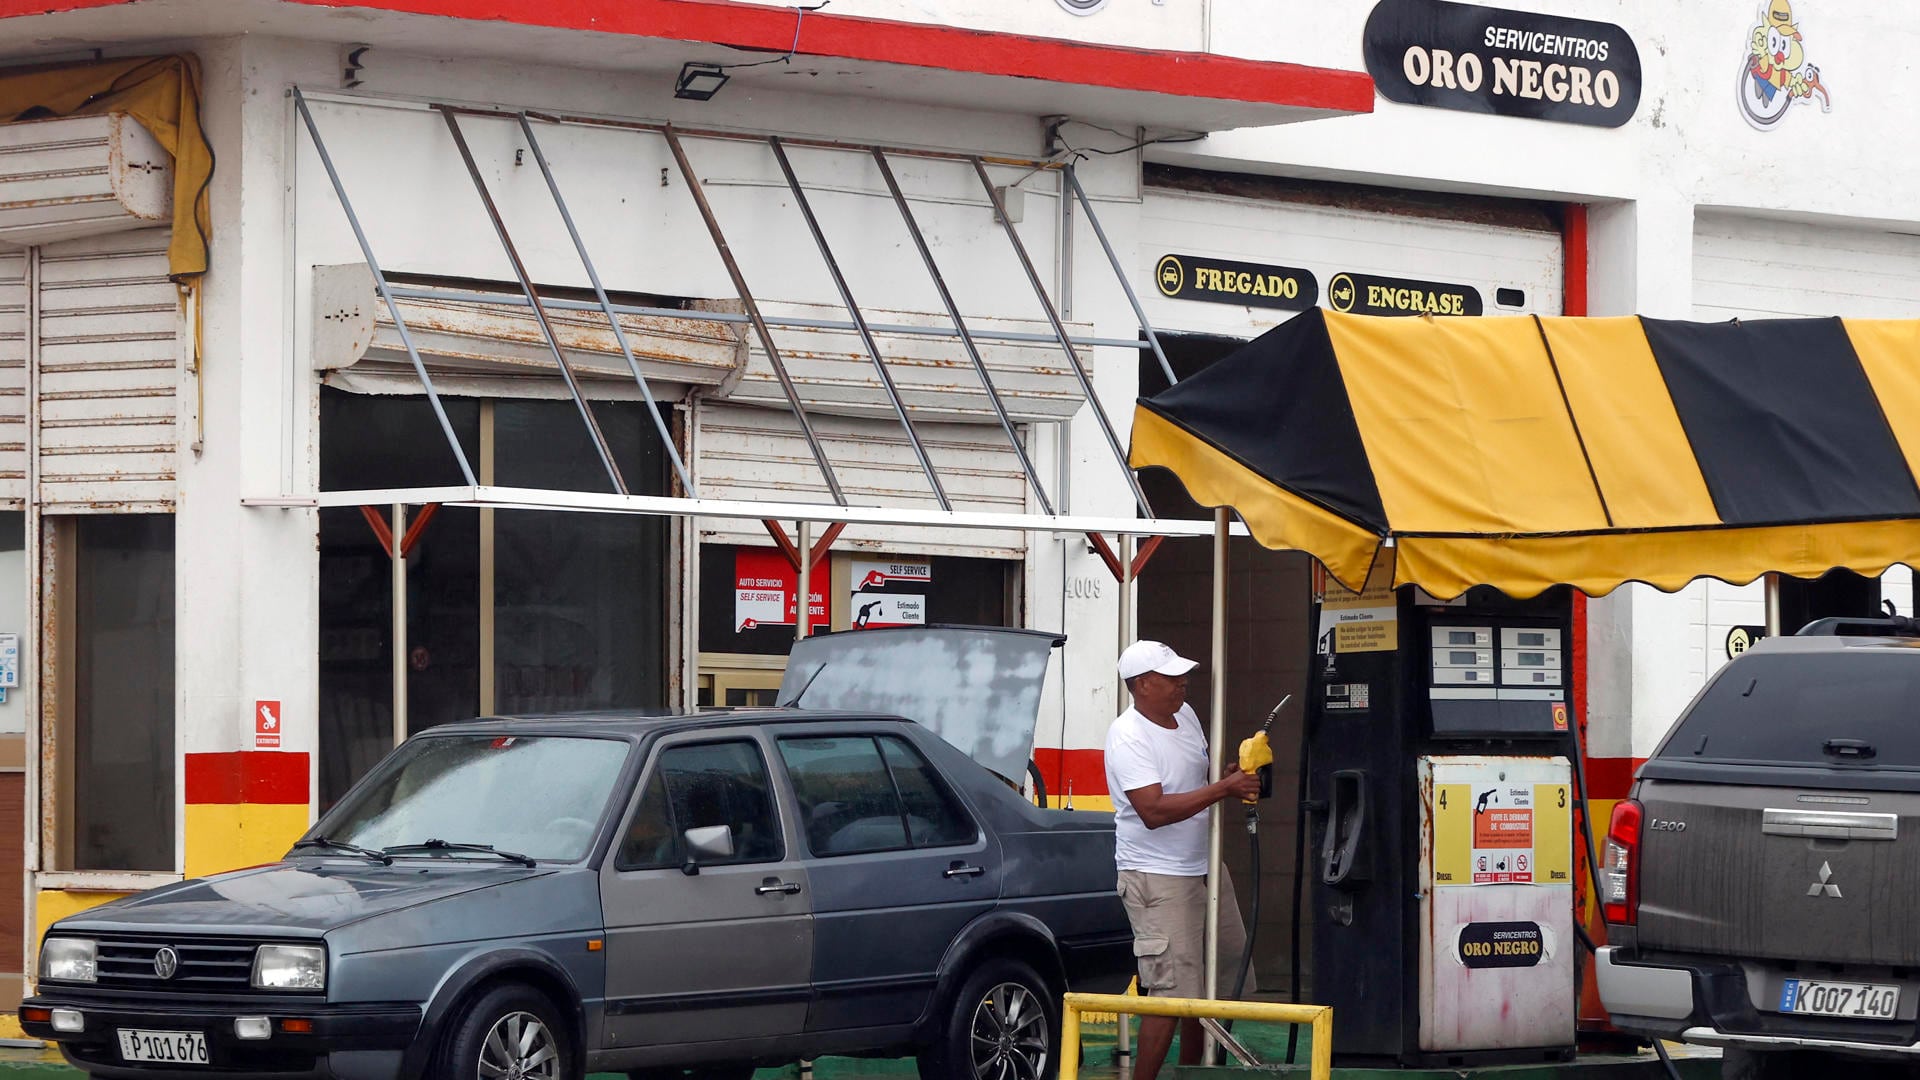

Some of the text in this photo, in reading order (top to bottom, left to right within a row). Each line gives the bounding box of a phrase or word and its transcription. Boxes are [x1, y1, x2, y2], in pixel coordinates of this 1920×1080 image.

[1485, 26, 1608, 61] SERVICENTROS
[1404, 46, 1619, 108] ORO NEGRO
[1195, 268, 1298, 298] FREGADO
[1368, 286, 1463, 315] ENGRASE
[890, 565, 926, 575] SELF SERVICE
[739, 578, 782, 587] AUTO SERVICIO
[1065, 576, 1104, 598] 4009
[1440, 790, 1447, 809] 4
[1558, 788, 1565, 808] 3
[1651, 819, 1686, 832] L200
[1494, 931, 1536, 939] SERVICENTROS
[1464, 941, 1538, 956] ORO NEGRO
